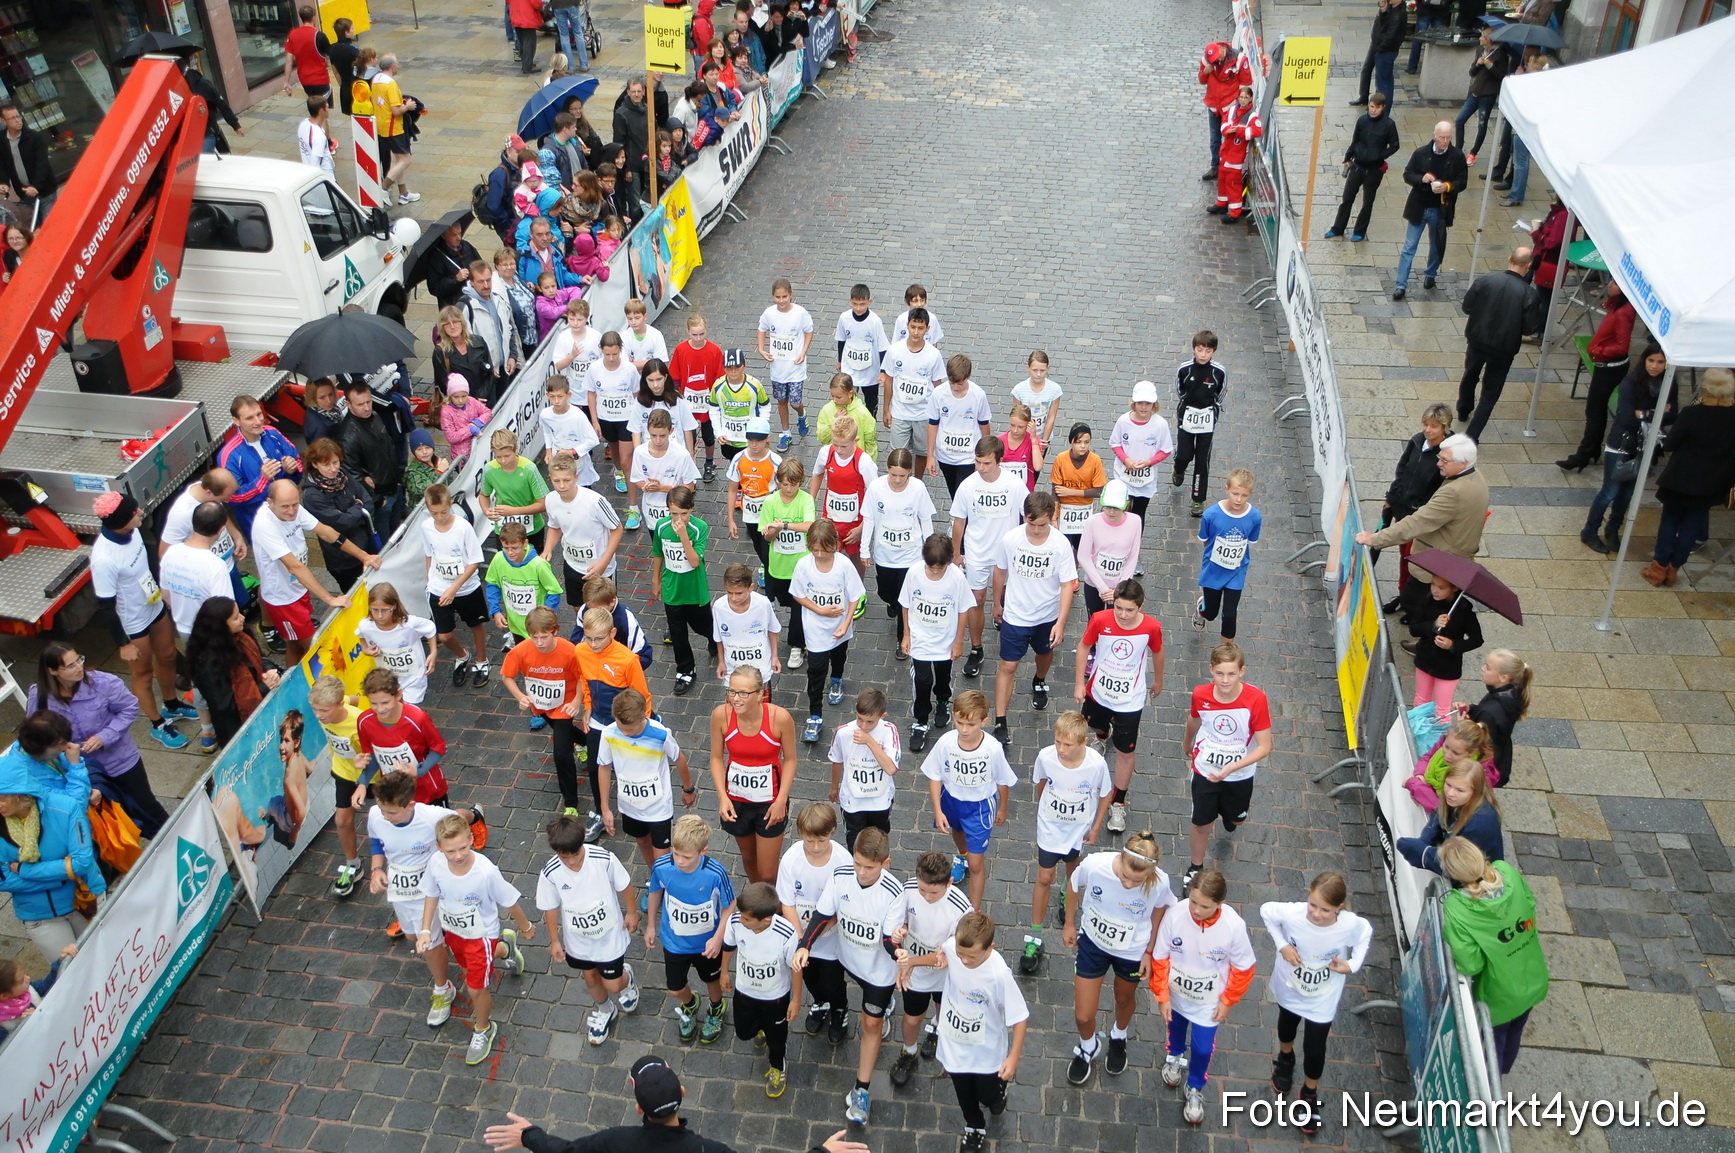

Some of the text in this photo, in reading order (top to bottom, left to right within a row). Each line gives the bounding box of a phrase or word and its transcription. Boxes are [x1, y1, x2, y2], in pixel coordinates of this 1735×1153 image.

[647, 24, 684, 38] Jugend-
[657, 38, 674, 48] lauf
[1284, 56, 1327, 69] Jugend-
[1295, 69, 1315, 80] lauf
[50, 110, 171, 322] Miet- & Serviceline. 09181 6352
[772, 340, 793, 351] 4040
[847, 350, 869, 362] 4048
[0, 352, 37, 421] Service
[900, 382, 924, 396] 4004
[602, 398, 627, 409] 4026
[687, 395, 710, 404] 4016
[1187, 414, 1211, 424] 4010
[725, 421, 747, 432] 4051
[944, 436, 971, 447] 4002
[828, 500, 855, 512] 4050
[978, 495, 1007, 507] 4053
[1063, 511, 1089, 522] 4044
[776, 532, 802, 543] 4005
[883, 531, 910, 542] 4013
[565, 546, 593, 559] 4019
[1216, 545, 1243, 558] 4032
[1019, 554, 1050, 568] 4054
[436, 563, 459, 576] 4041
[1016, 566, 1045, 579] Patrick
[506, 591, 532, 604] 4022
[812, 594, 841, 607] 4046
[916, 602, 947, 617] 4045
[383, 654, 413, 667] 4036
[730, 649, 762, 661] 4058
[529, 683, 561, 699] 4000
[1099, 675, 1130, 694] 4033
[1104, 692, 1118, 700] Jonas
[536, 699, 552, 707] Daniel
[953, 759, 987, 775] 4052
[731, 773, 768, 789] 4062
[852, 769, 884, 784] 4017
[956, 774, 987, 786] ALEX
[623, 783, 656, 798] 4061
[1050, 799, 1085, 815] 4014
[1056, 814, 1077, 822] Patrick
[442, 914, 475, 929] 4057
[572, 907, 606, 929] 4038
[672, 908, 709, 924] 4059
[583, 926, 604, 937] Philipp
[839, 917, 875, 940] 4008
[1090, 916, 1127, 943] 4031
[843, 930, 870, 948] Sebastian
[1094, 932, 1113, 947] Teresa
[741, 961, 776, 980] 4030
[1293, 966, 1330, 985] 4009
[1173, 976, 1213, 993] 4024
[90, 933, 172, 1059] BESSER.
[946, 1009, 980, 1033] 4056
[22, 1040, 69, 1120] UNS
